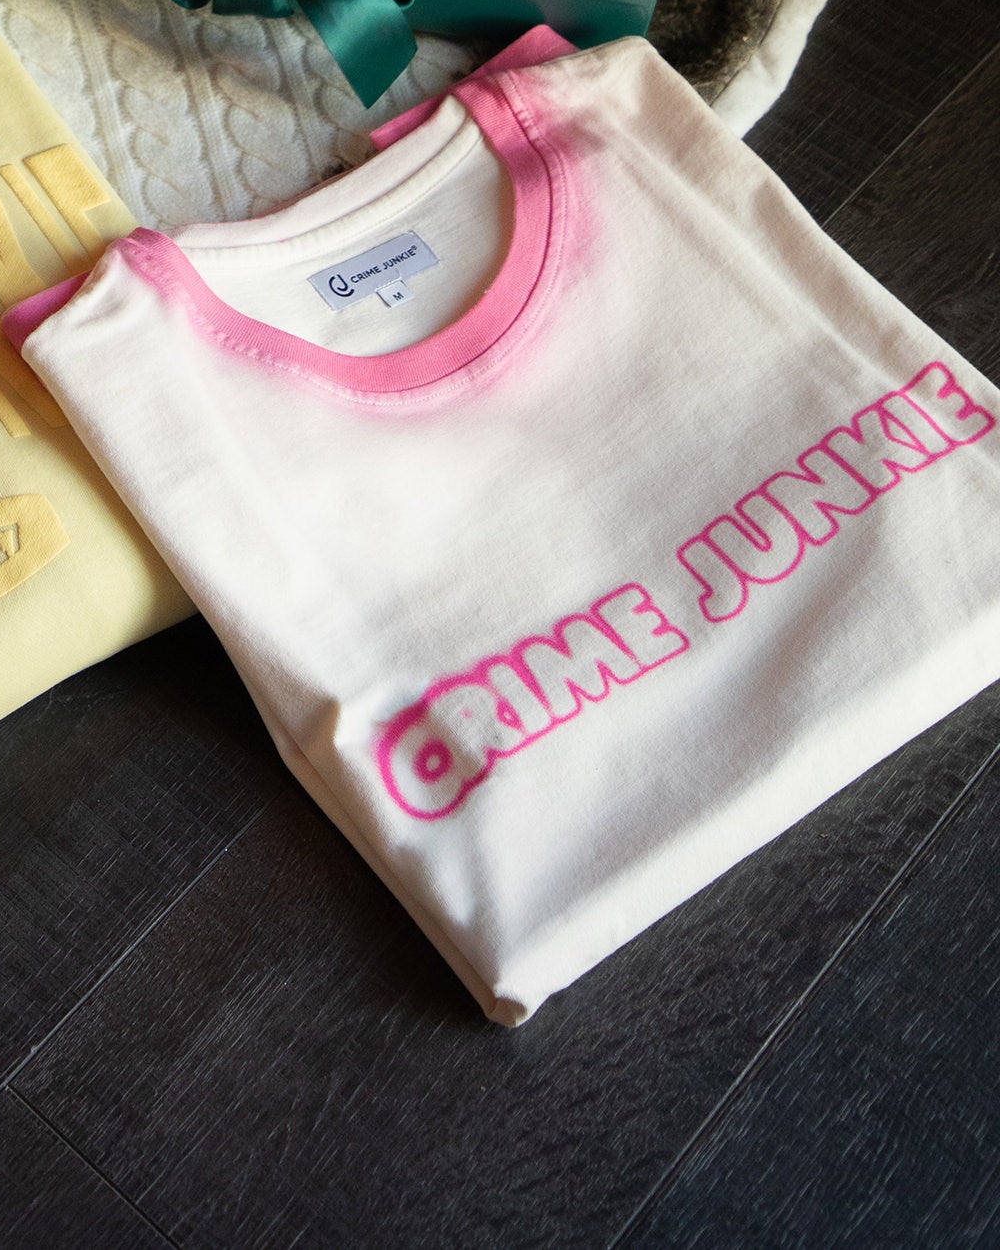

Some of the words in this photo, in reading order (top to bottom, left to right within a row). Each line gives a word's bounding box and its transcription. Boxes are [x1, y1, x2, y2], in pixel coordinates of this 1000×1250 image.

[350, 264, 382, 284] CRIME
[392, 291, 404, 301] M
[372, 582, 690, 821] CRIME
[676, 361, 997, 623] JUNKIE
